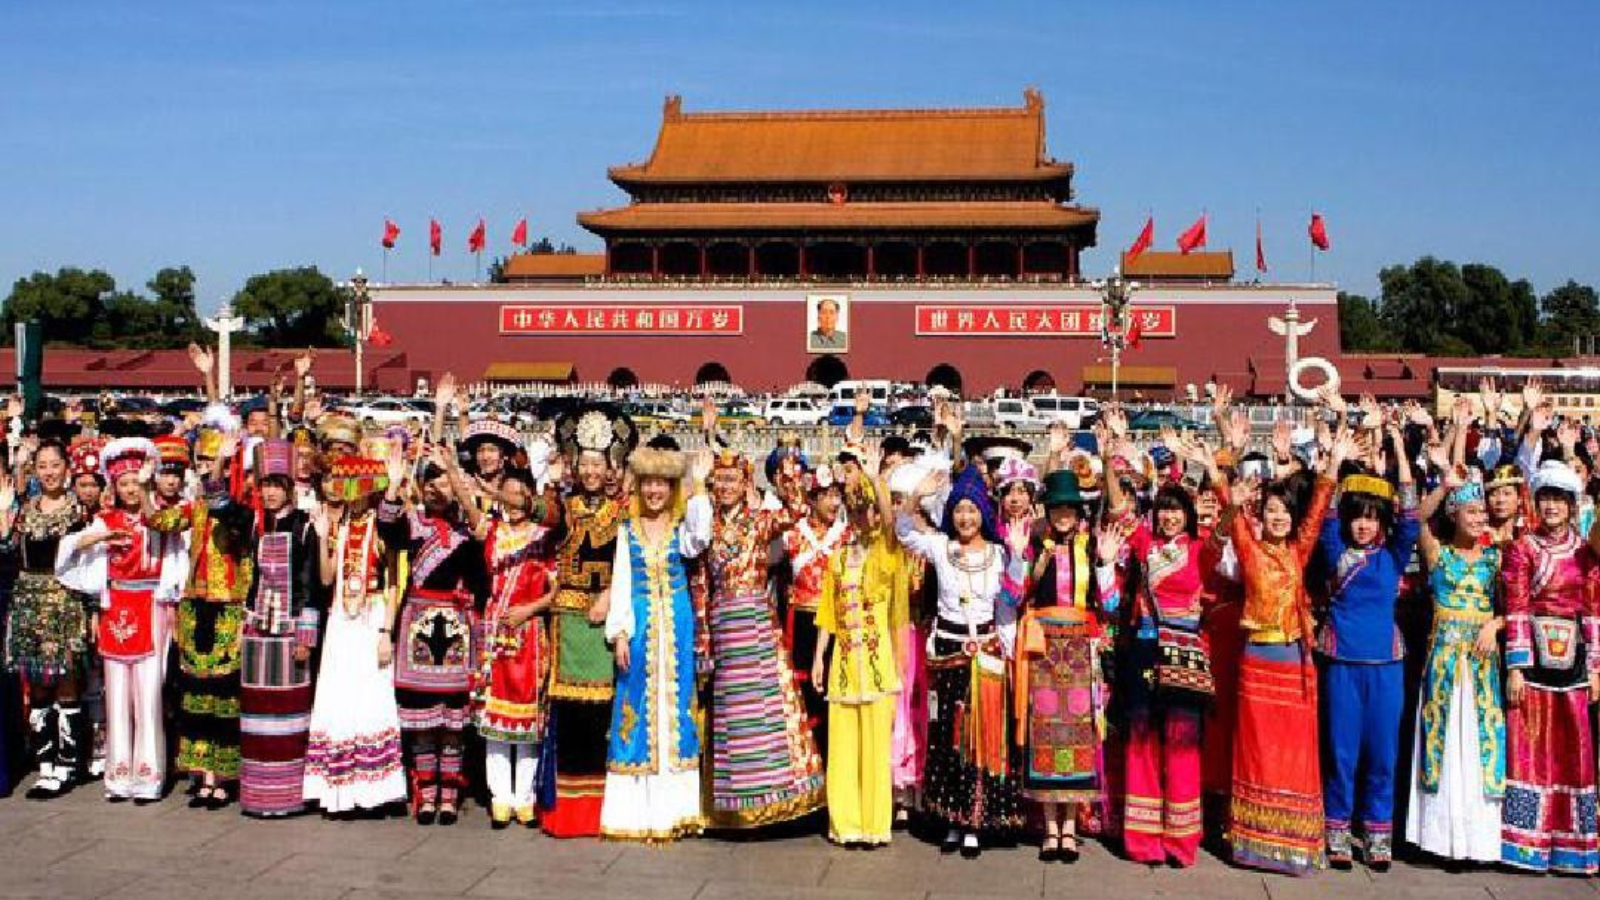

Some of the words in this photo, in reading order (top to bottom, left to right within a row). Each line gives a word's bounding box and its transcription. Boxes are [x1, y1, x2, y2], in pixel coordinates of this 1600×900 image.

[513, 309, 729, 329] 中华人民共和国万岁
